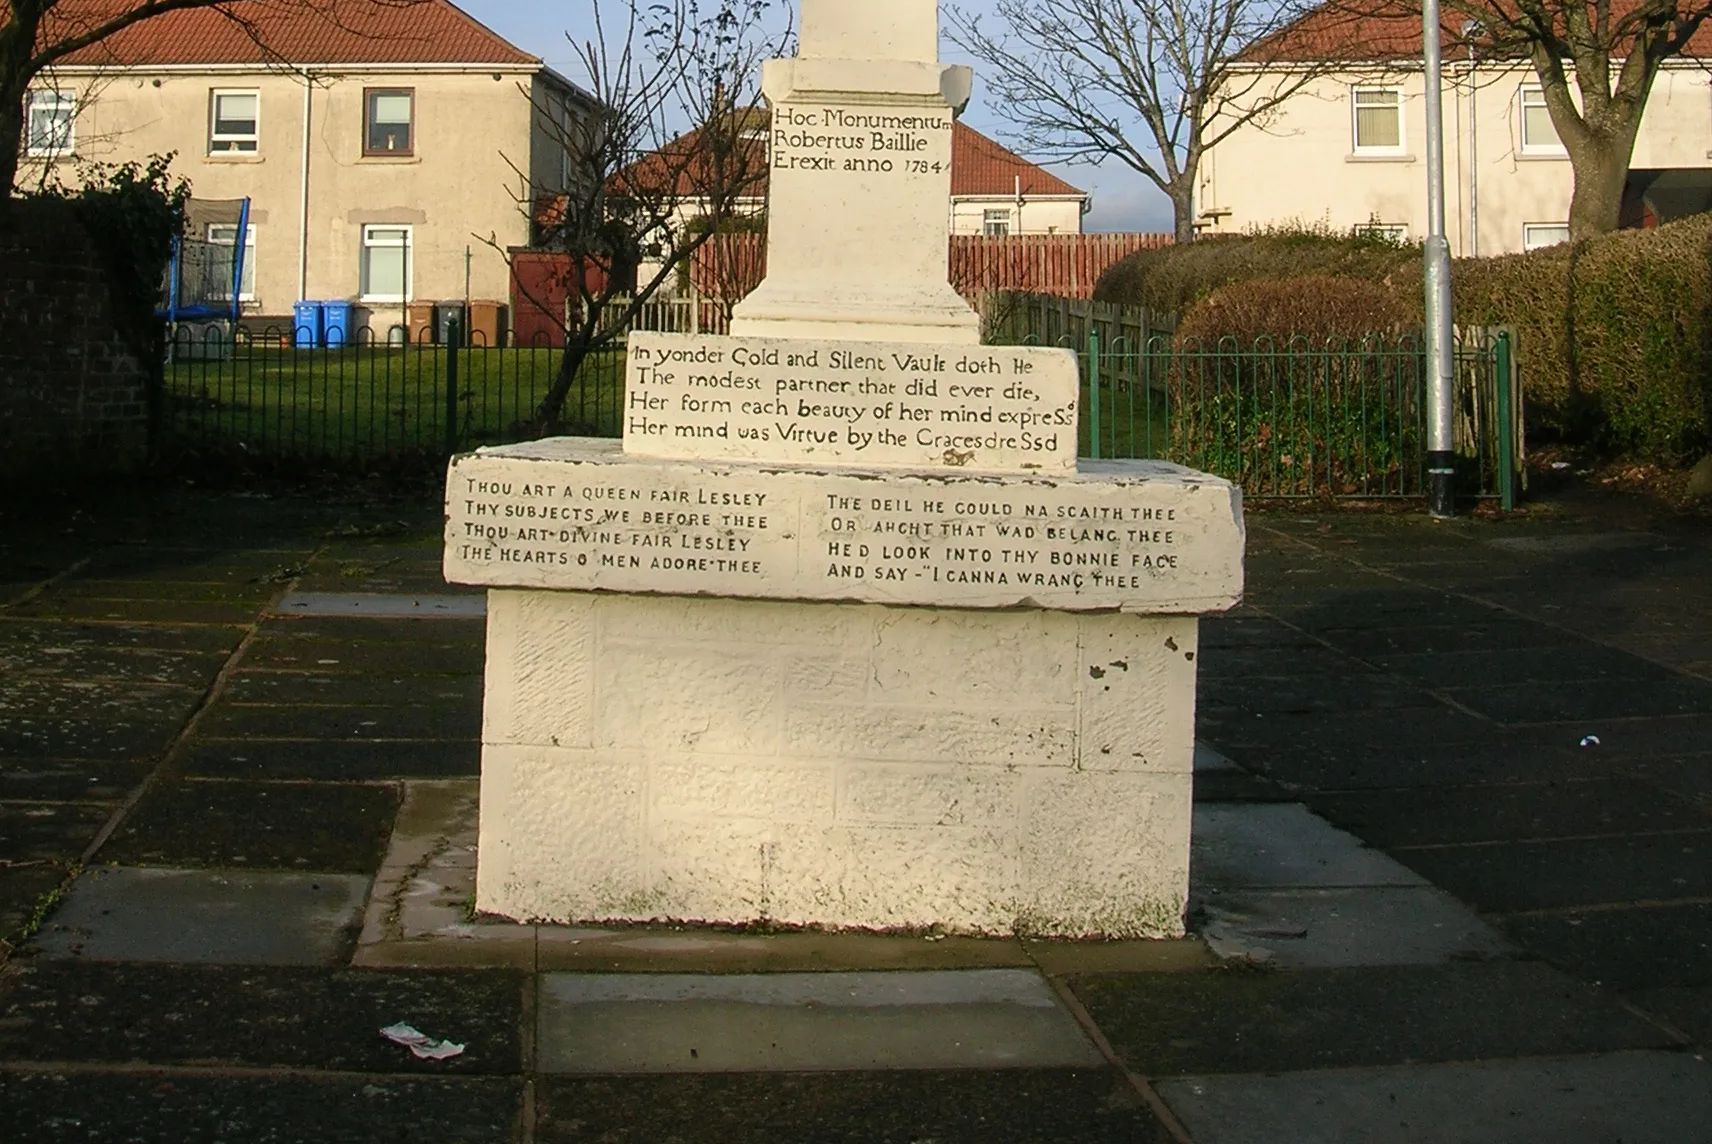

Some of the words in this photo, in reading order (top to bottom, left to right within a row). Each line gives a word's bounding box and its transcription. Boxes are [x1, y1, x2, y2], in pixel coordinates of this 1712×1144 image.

[775, 108, 817, 126] Hoc
[824, 108, 952, 130] Monumentum
[774, 130, 865, 149] Robertus
[870, 131, 928, 152] Baillie
[773, 151, 836, 170] Erexit
[844, 159, 893, 172] anno
[904, 159, 943, 174] 1784
[632, 345, 650, 360] In
[654, 346, 725, 367] yonder
[787, 350, 819, 367] and
[828, 350, 886, 371] Silent
[955, 356, 1002, 374] doth
[1013, 358, 1033, 374] He
[636, 367, 675, 384] The
[688, 371, 761, 389] modest
[775, 378, 852, 396] partner
[858, 377, 897, 394] that
[905, 378, 938, 397] did
[949, 384, 995, 398] ever
[1003, 381, 1041, 402] die,
[629, 391, 669, 410] Her
[681, 393, 731, 413] form
[741, 397, 789, 415] each
[797, 398, 867, 424] beauty
[873, 402, 895, 420] of
[899, 403, 933, 421] her
[940, 405, 992, 423] mind
[629, 416, 667, 435] Her
[675, 421, 729, 439] mind
[738, 427, 770, 441] was
[775, 422, 839, 444] Virtue
[847, 425, 873, 451] by
[878, 429, 908, 447] the
[467, 478, 512, 495] THOU
[522, 484, 556, 497] ART
[563, 486, 573, 498] A
[582, 487, 640, 500] QUEEN
[651, 490, 690, 503] FAIR
[698, 488, 767, 506] LESLEY
[465, 500, 500, 516] THY
[505, 505, 594, 522] SUBJECTS
[604, 509, 630, 522] WE
[643, 511, 711, 526] BEFORE
[722, 515, 768, 529] THEE
[827, 494, 861, 510] THE
[871, 499, 912, 512] DEIL
[923, 501, 944, 513] HE
[955, 502, 1012, 516] COULD
[1025, 504, 1048, 516] NA
[1057, 506, 1123, 520] SCAITH
[1131, 508, 1175, 521] THEE
[464, 522, 508, 539] THOU
[517, 528, 552, 541] ART
[559, 530, 621, 545] DIVINE
[632, 533, 672, 548] FAIR
[682, 534, 750, 552] LESLEY
[831, 517, 856, 532] OR
[940, 523, 986, 537] THAT
[996, 524, 1034, 538] WAD
[1128, 530, 1173, 543] THEE
[462, 545, 492, 560] THE
[500, 548, 568, 565] HEARTS
[602, 554, 640, 568] MEN
[651, 557, 708, 571] ADORE
[717, 560, 761, 574] THEE
[883, 546, 930, 559] LOOK
[946, 548, 992, 562] INTO
[1001, 550, 1039, 563] THY
[1051, 552, 1119, 567] BONNIE
[1132, 554, 1178, 568] FACE
[827, 563, 865, 579] AND
[874, 567, 908, 581] SAY
[946, 570, 1008, 585] CANNA
[1093, 573, 1139, 588] THEE
